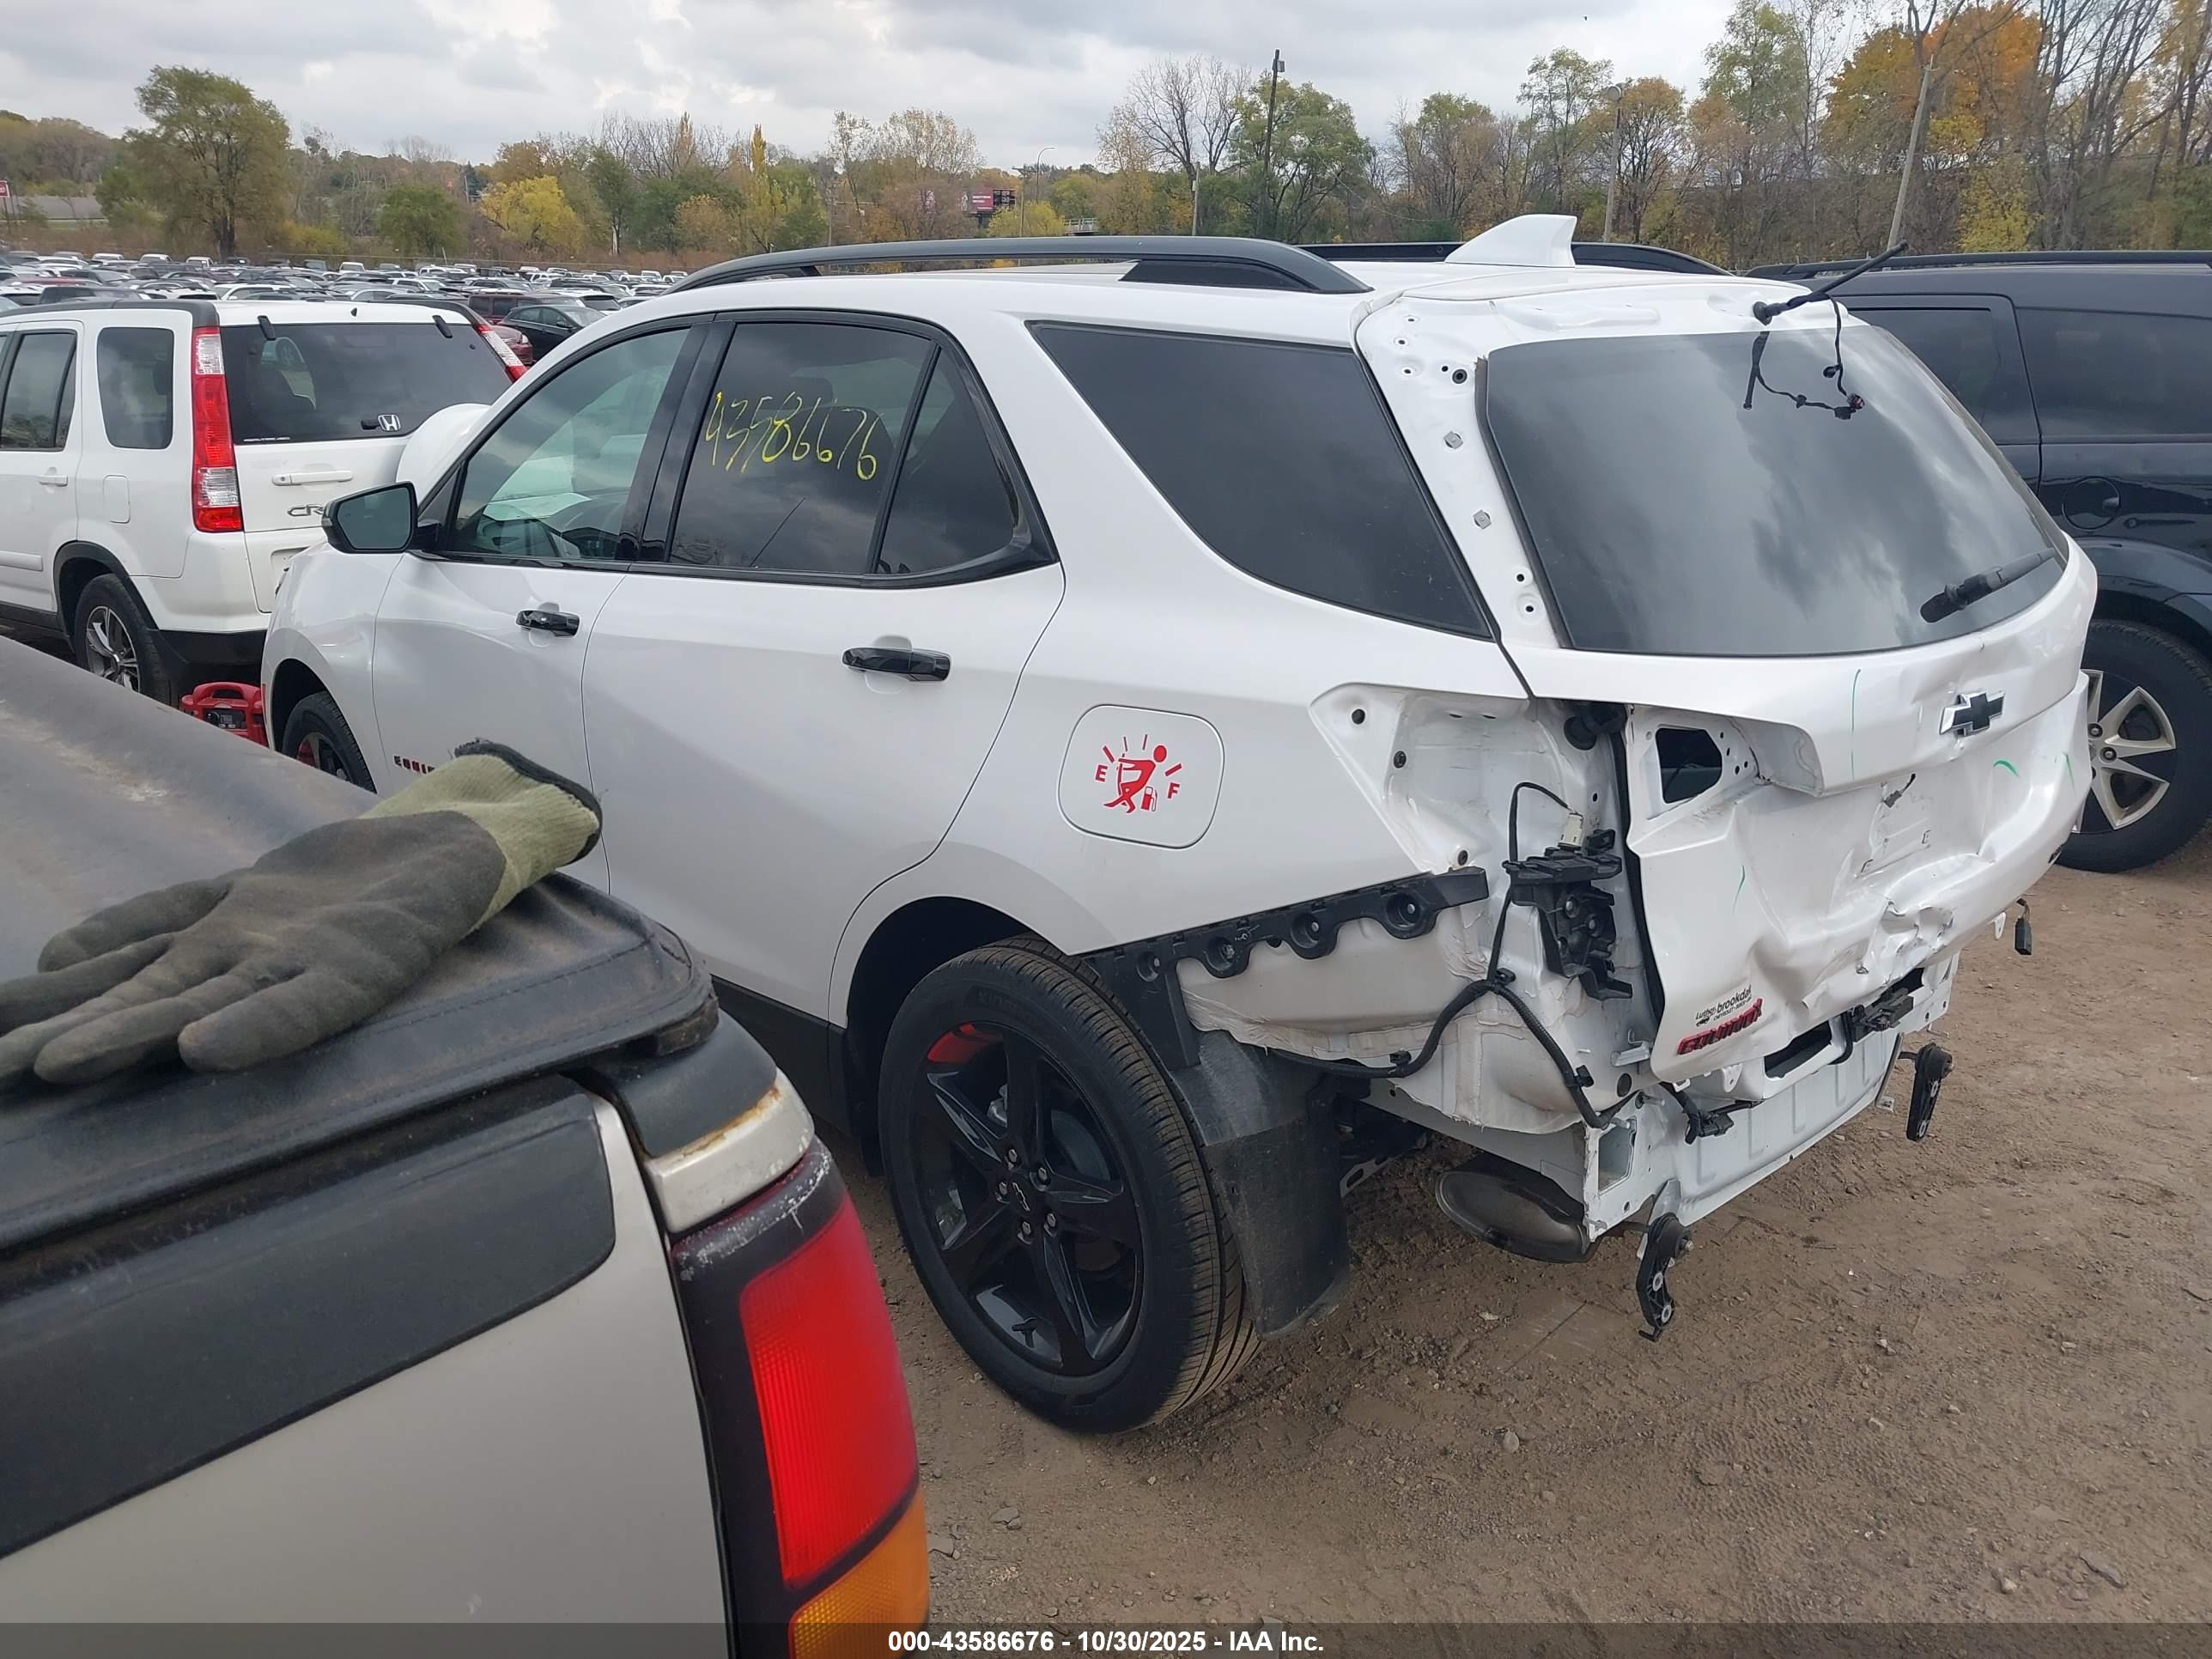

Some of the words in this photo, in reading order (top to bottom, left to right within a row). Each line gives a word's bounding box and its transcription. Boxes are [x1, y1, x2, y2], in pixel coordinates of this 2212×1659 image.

[705, 392, 884, 481] 43586676
[1095, 764, 1109, 782] E
[1167, 782, 1181, 799] F
